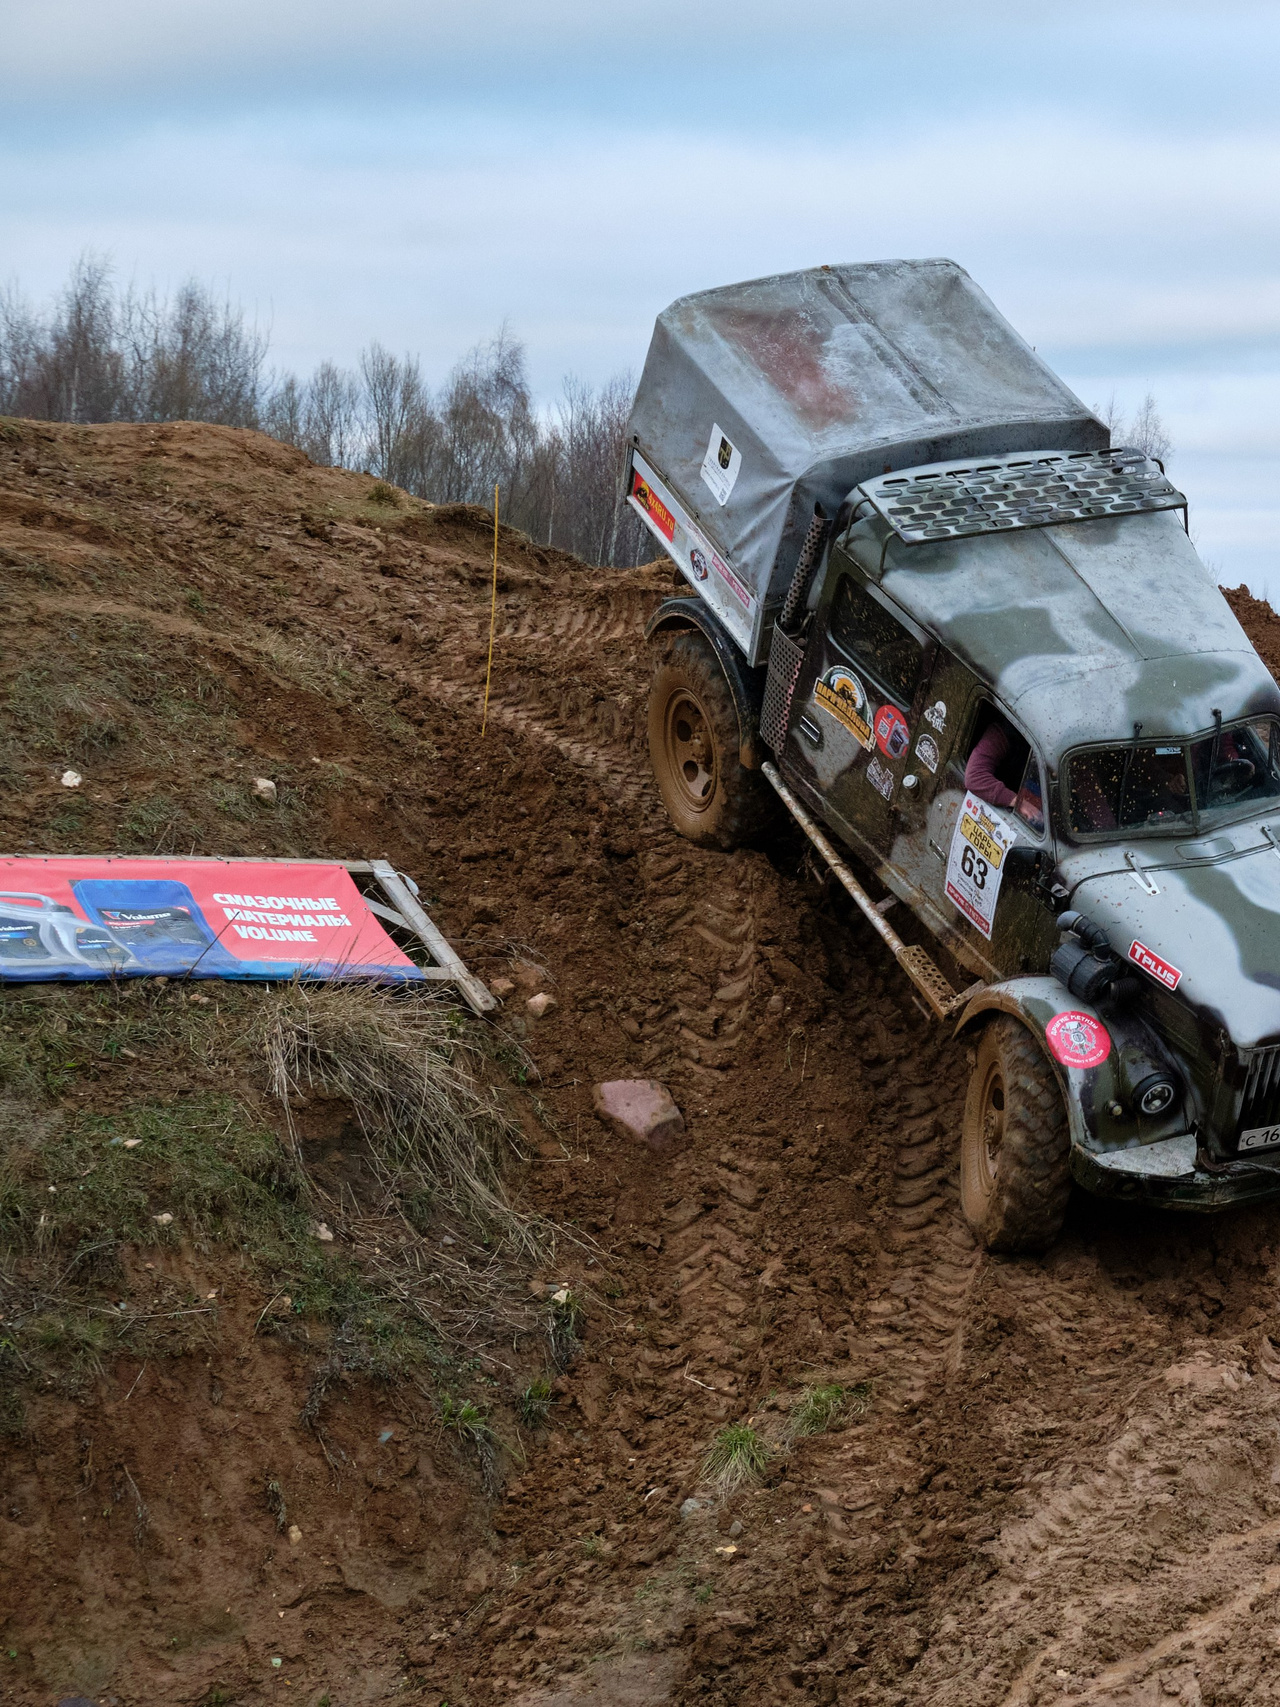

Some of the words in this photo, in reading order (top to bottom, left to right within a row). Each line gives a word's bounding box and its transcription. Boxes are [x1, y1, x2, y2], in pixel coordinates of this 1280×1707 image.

[969, 832, 992, 859] ГОРЫ
[973, 825, 992, 849] ЦАРЬ
[961, 845, 988, 890] 63
[212, 893, 341, 911] СМАЗОЧНЫЕ
[120, 912, 172, 920] Volume
[222, 907, 352, 927] МАТЕРИАЛЫ
[232, 925, 318, 943] VOLUME
